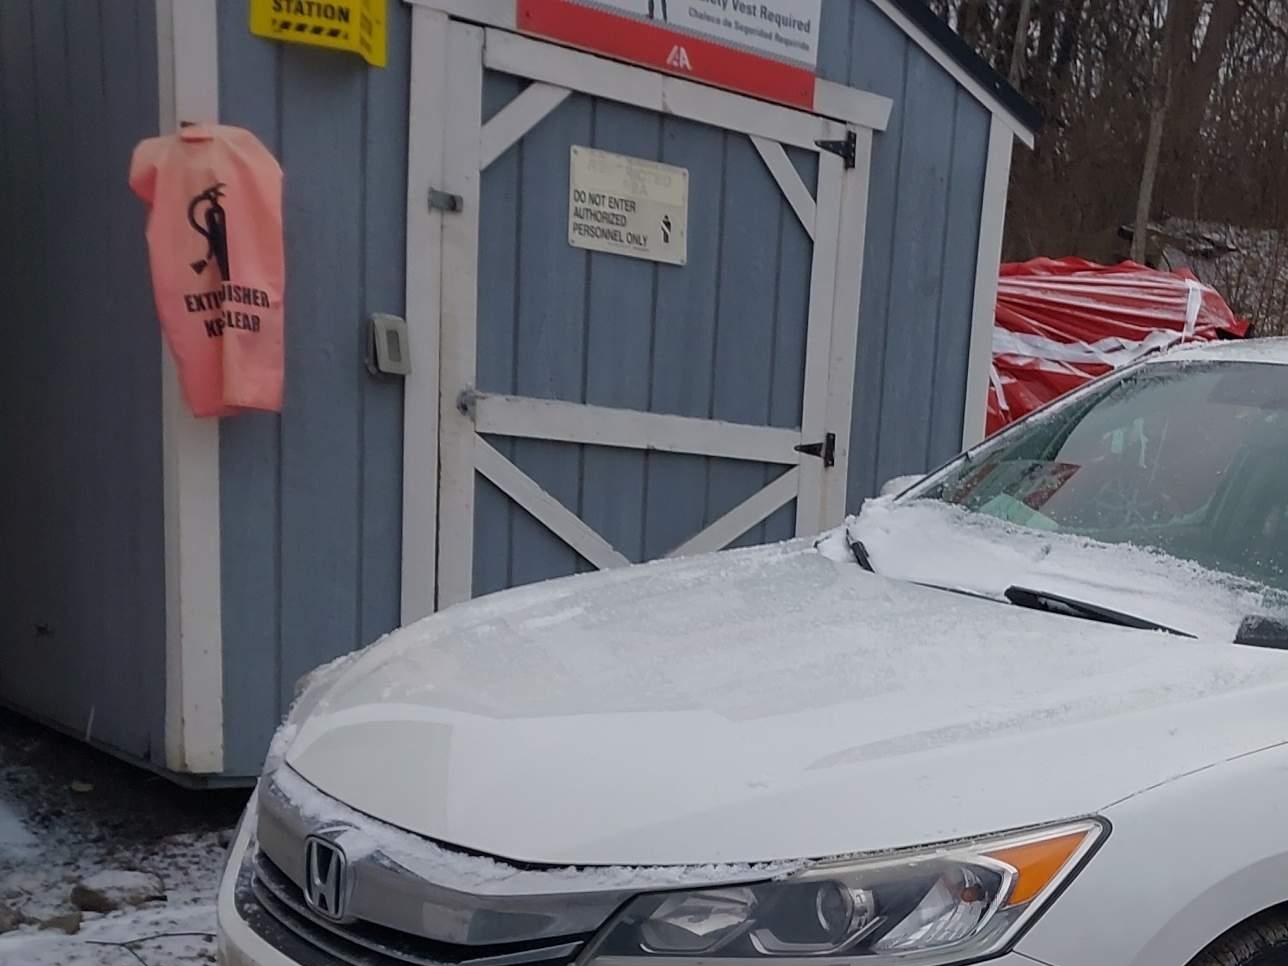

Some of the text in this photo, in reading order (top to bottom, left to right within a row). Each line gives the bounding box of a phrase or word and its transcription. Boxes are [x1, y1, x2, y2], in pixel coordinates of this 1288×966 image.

[272, 0, 350, 23] STATION
[732, 0, 757, 16] Vest
[760, 5, 811, 33] Required
[573, 189, 636, 213] DO NOT ENTER
[573, 206, 627, 227] AUTHORIZED
[573, 222, 648, 247] PERSONNEL ONLY
